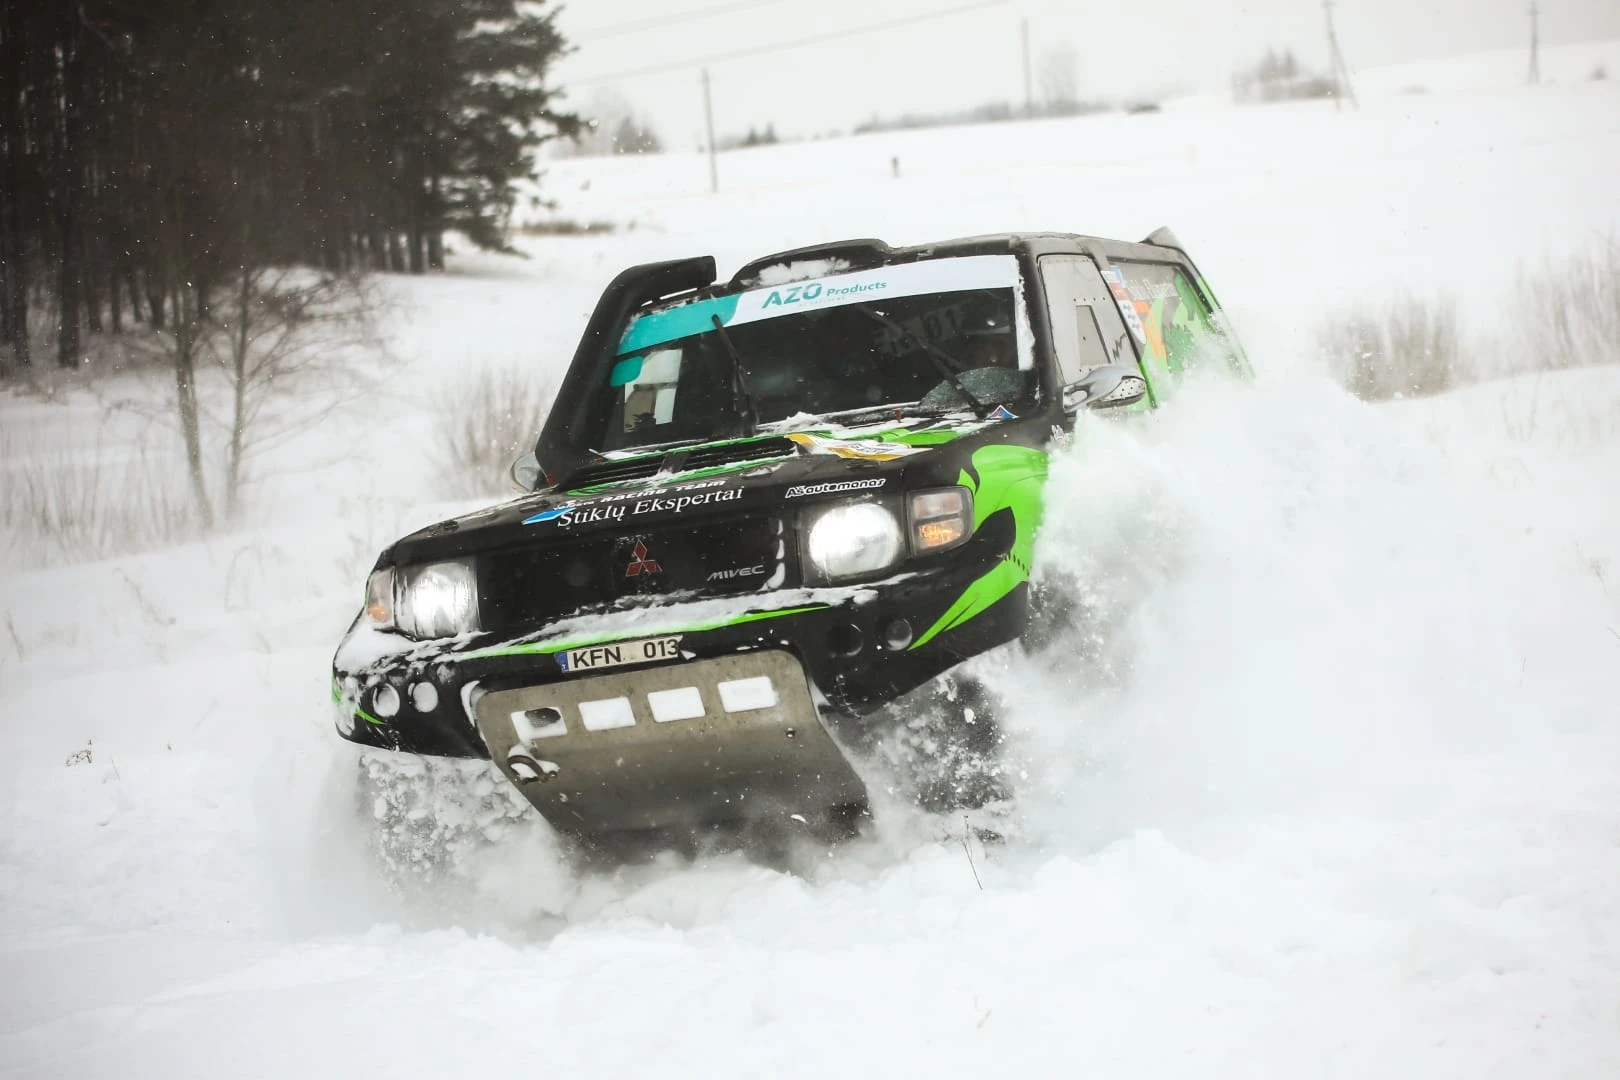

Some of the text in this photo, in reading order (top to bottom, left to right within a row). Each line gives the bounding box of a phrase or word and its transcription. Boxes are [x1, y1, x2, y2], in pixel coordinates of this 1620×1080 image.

[762, 283, 822, 309] AZO
[826, 281, 887, 297] Products
[632, 486, 745, 514] Ekspertai
[706, 564, 766, 582] MIVEC
[573, 639, 678, 668] KFN 013
